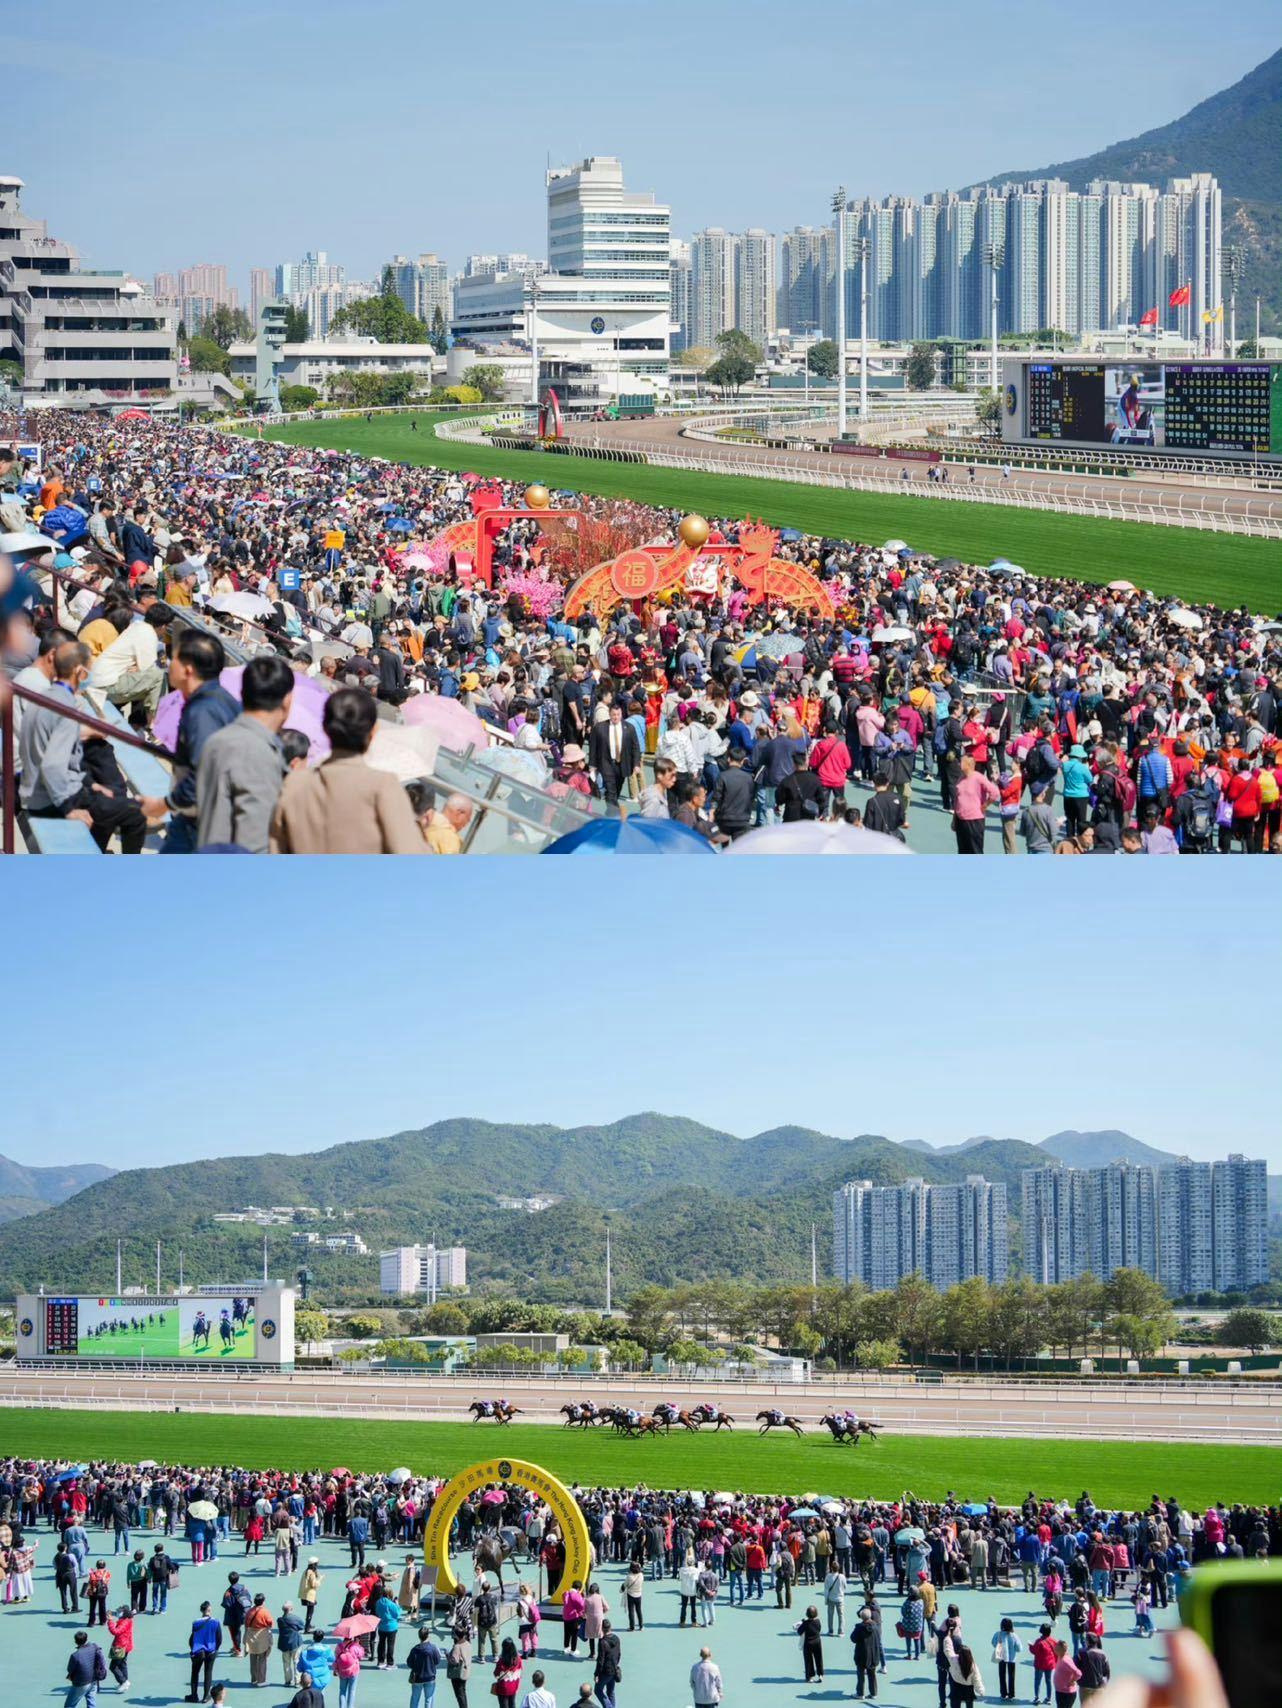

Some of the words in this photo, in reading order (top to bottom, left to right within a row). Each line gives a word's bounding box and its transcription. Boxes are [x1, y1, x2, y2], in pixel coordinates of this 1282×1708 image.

[284, 572, 295, 586] E
[621, 561, 648, 588] 福
[558, 1501, 569, 1518] Hong
[566, 1516, 577, 1535] Kong
[572, 1535, 580, 1559] Jockey
[572, 1559, 580, 1574] Club
